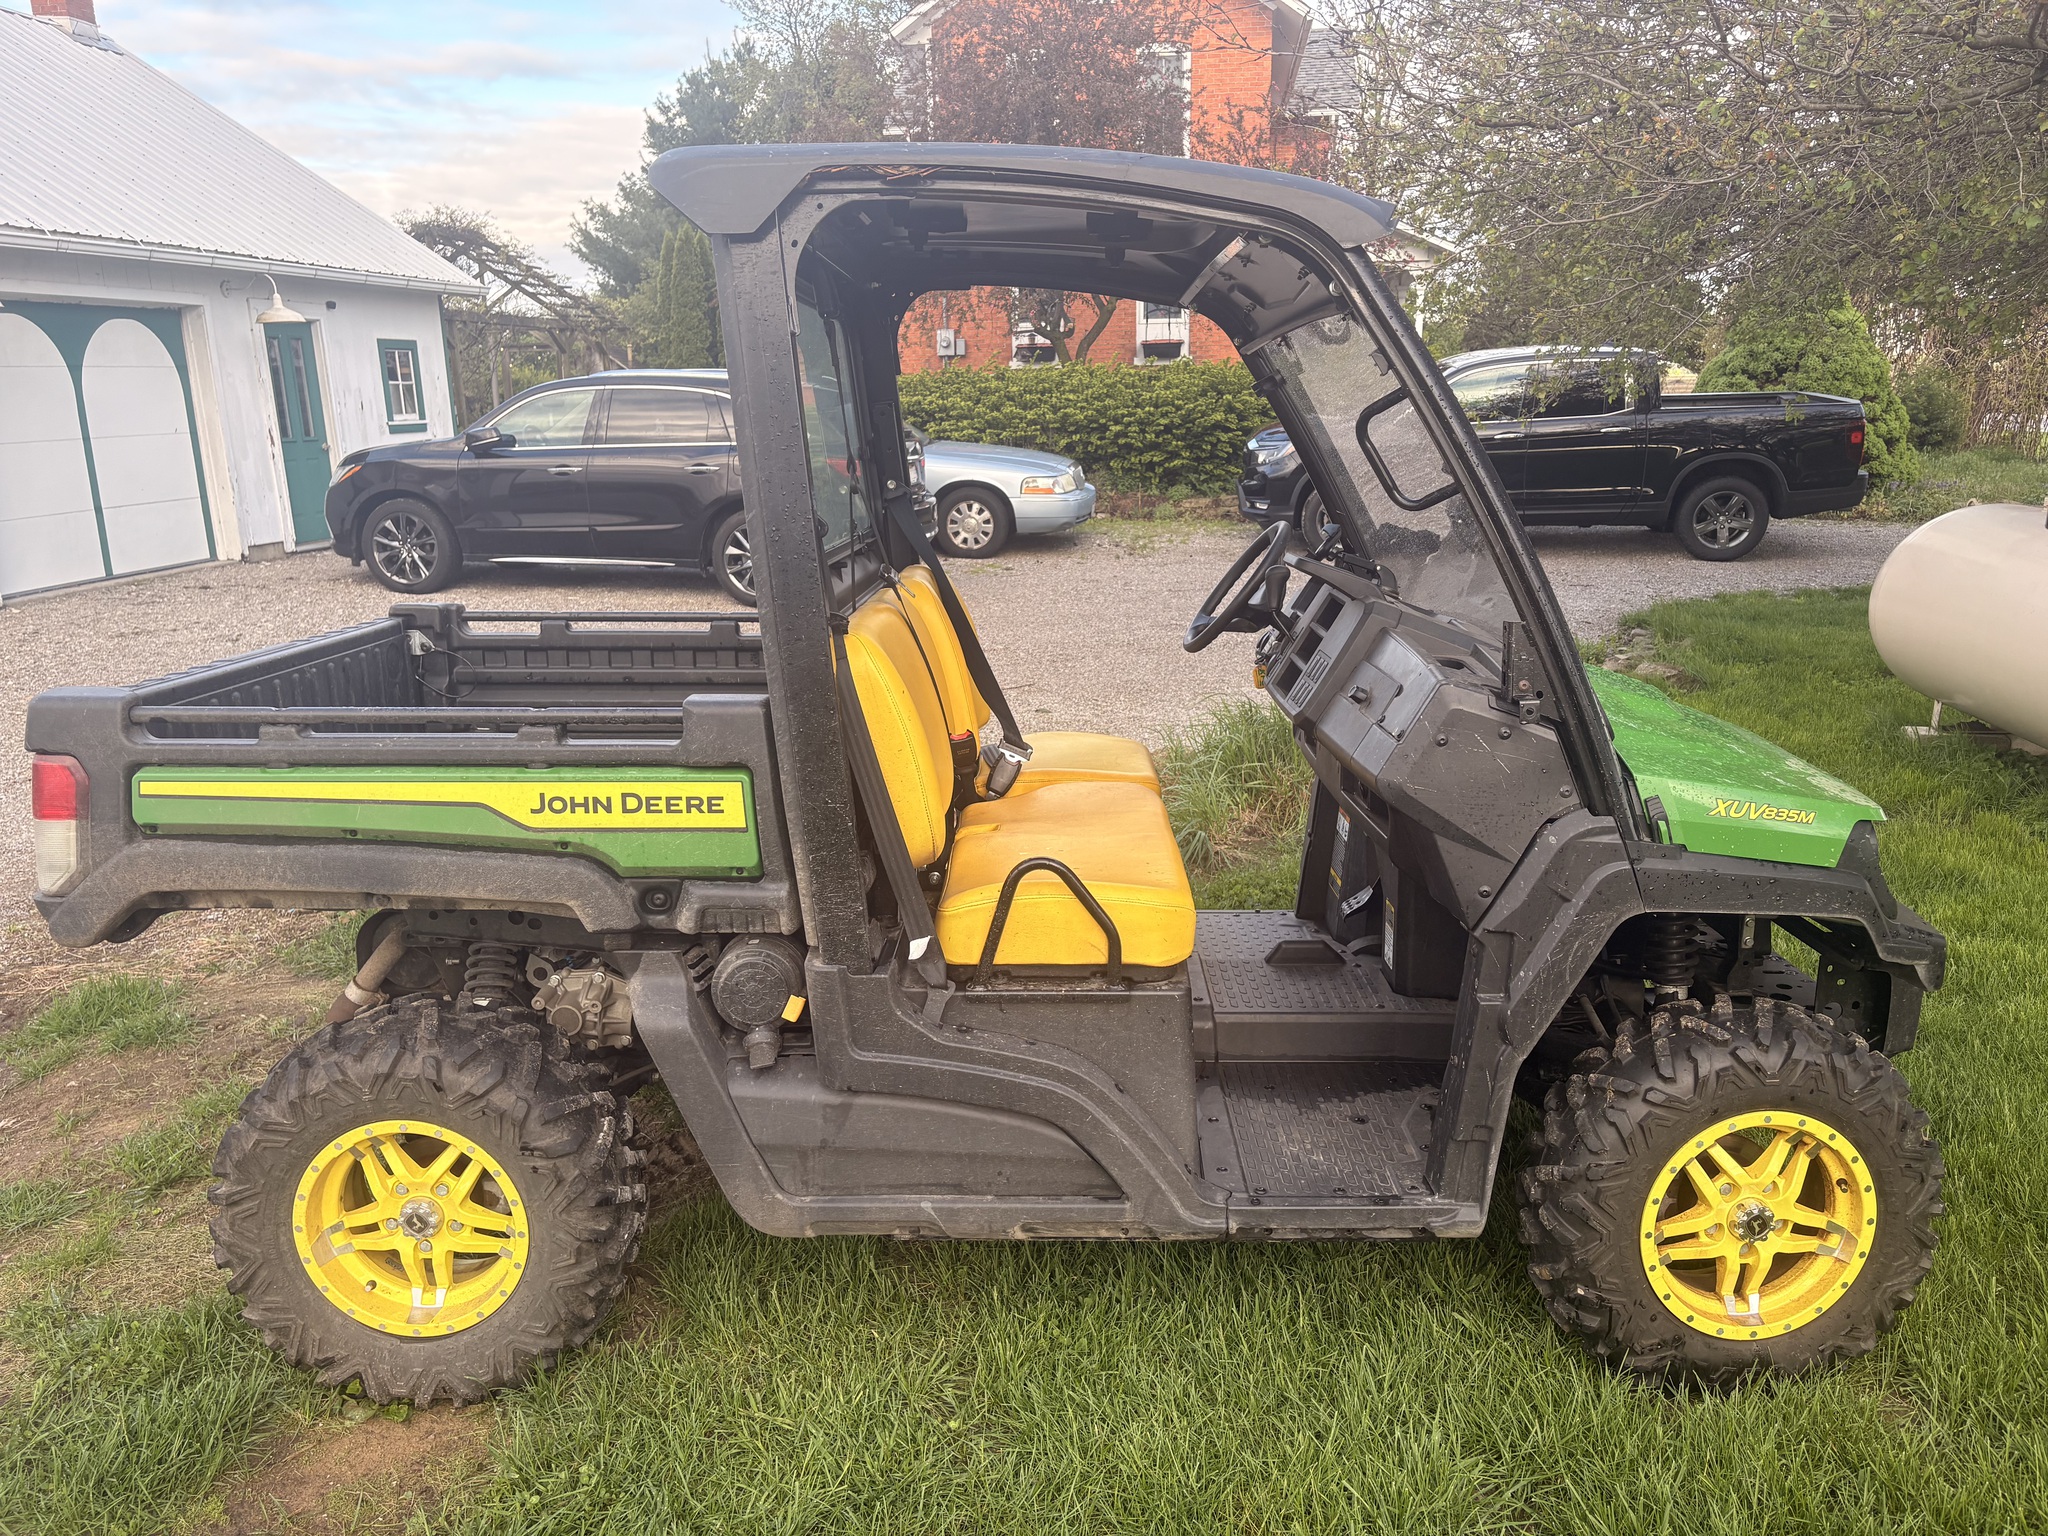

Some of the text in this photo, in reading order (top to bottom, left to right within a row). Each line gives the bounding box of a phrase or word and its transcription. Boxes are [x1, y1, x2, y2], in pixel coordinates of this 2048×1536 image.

[530, 792, 725, 815] JOHN DEERE
[1706, 798, 1816, 825] XUV835M
